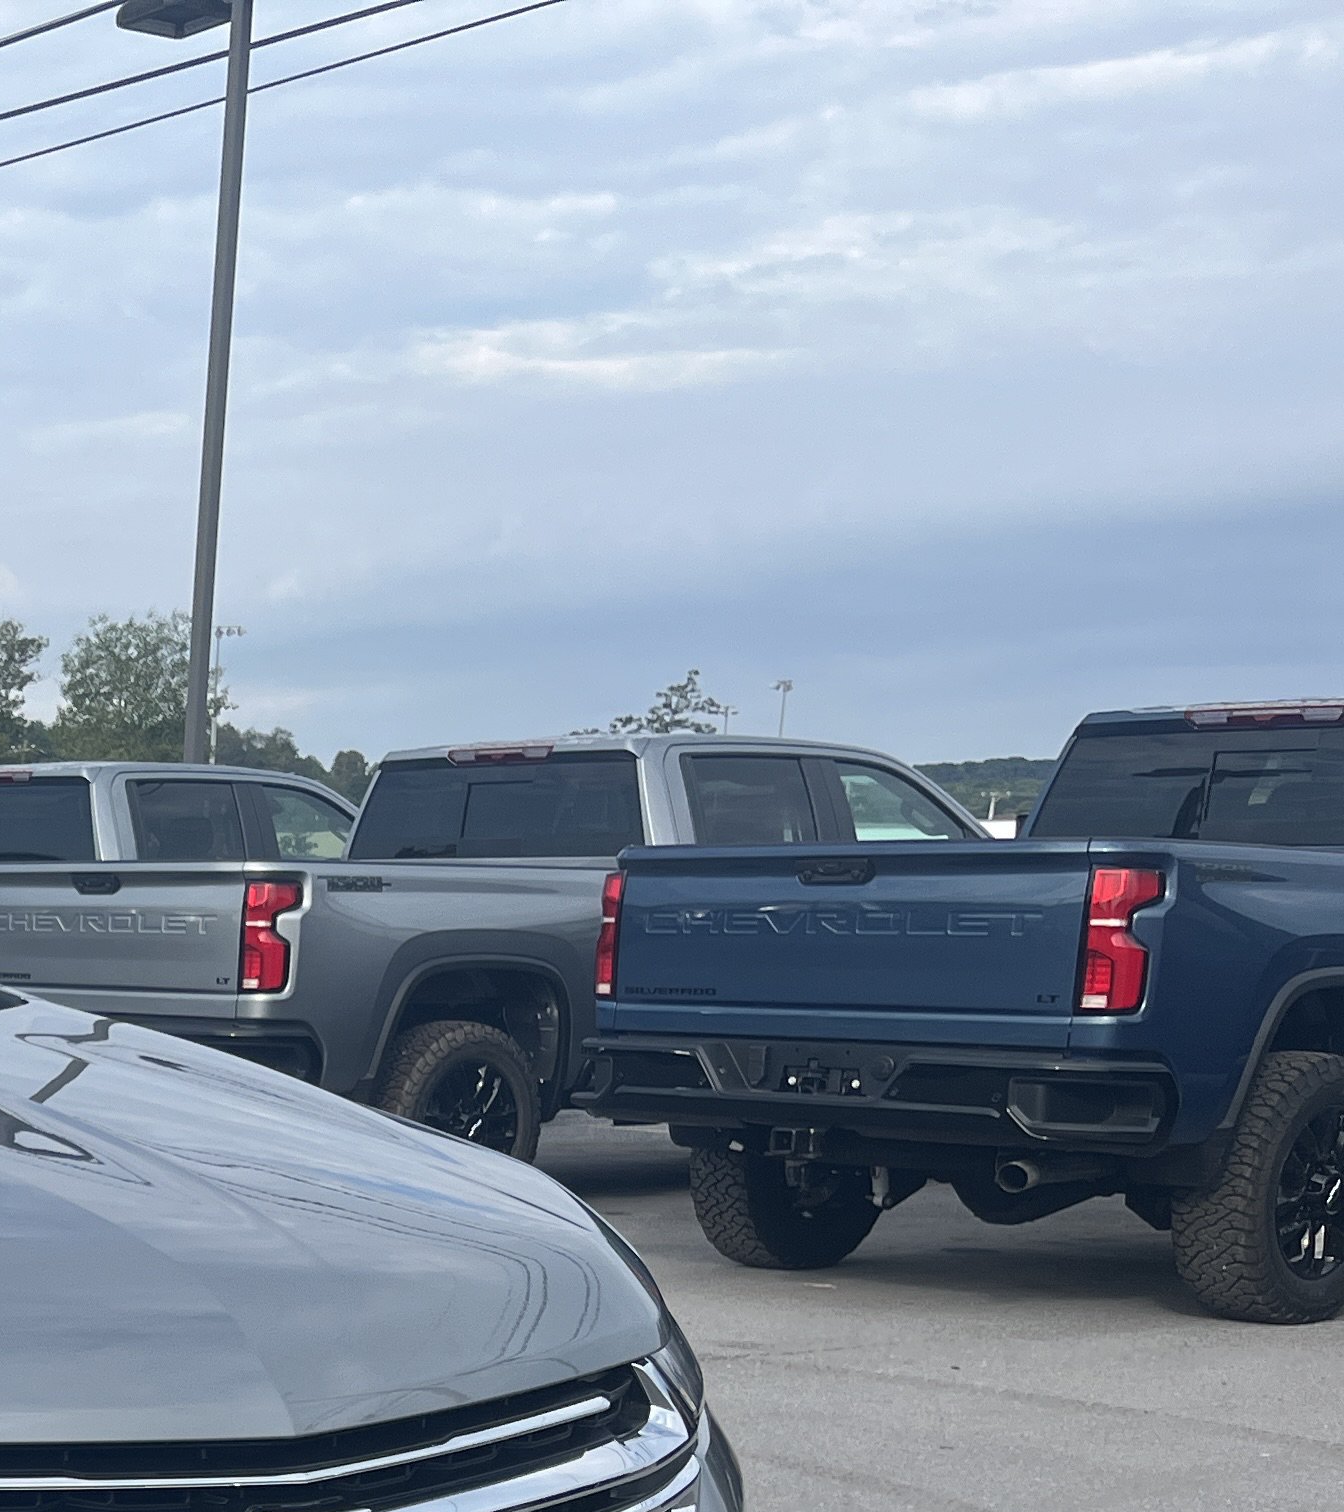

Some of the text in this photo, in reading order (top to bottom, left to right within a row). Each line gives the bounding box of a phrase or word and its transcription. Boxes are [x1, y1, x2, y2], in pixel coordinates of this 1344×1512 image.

[645, 911, 1044, 935] CHEVROLET
[216, 977, 230, 985] LT
[623, 985, 717, 996] SILVERADO
[1036, 994, 1060, 1004] LT
